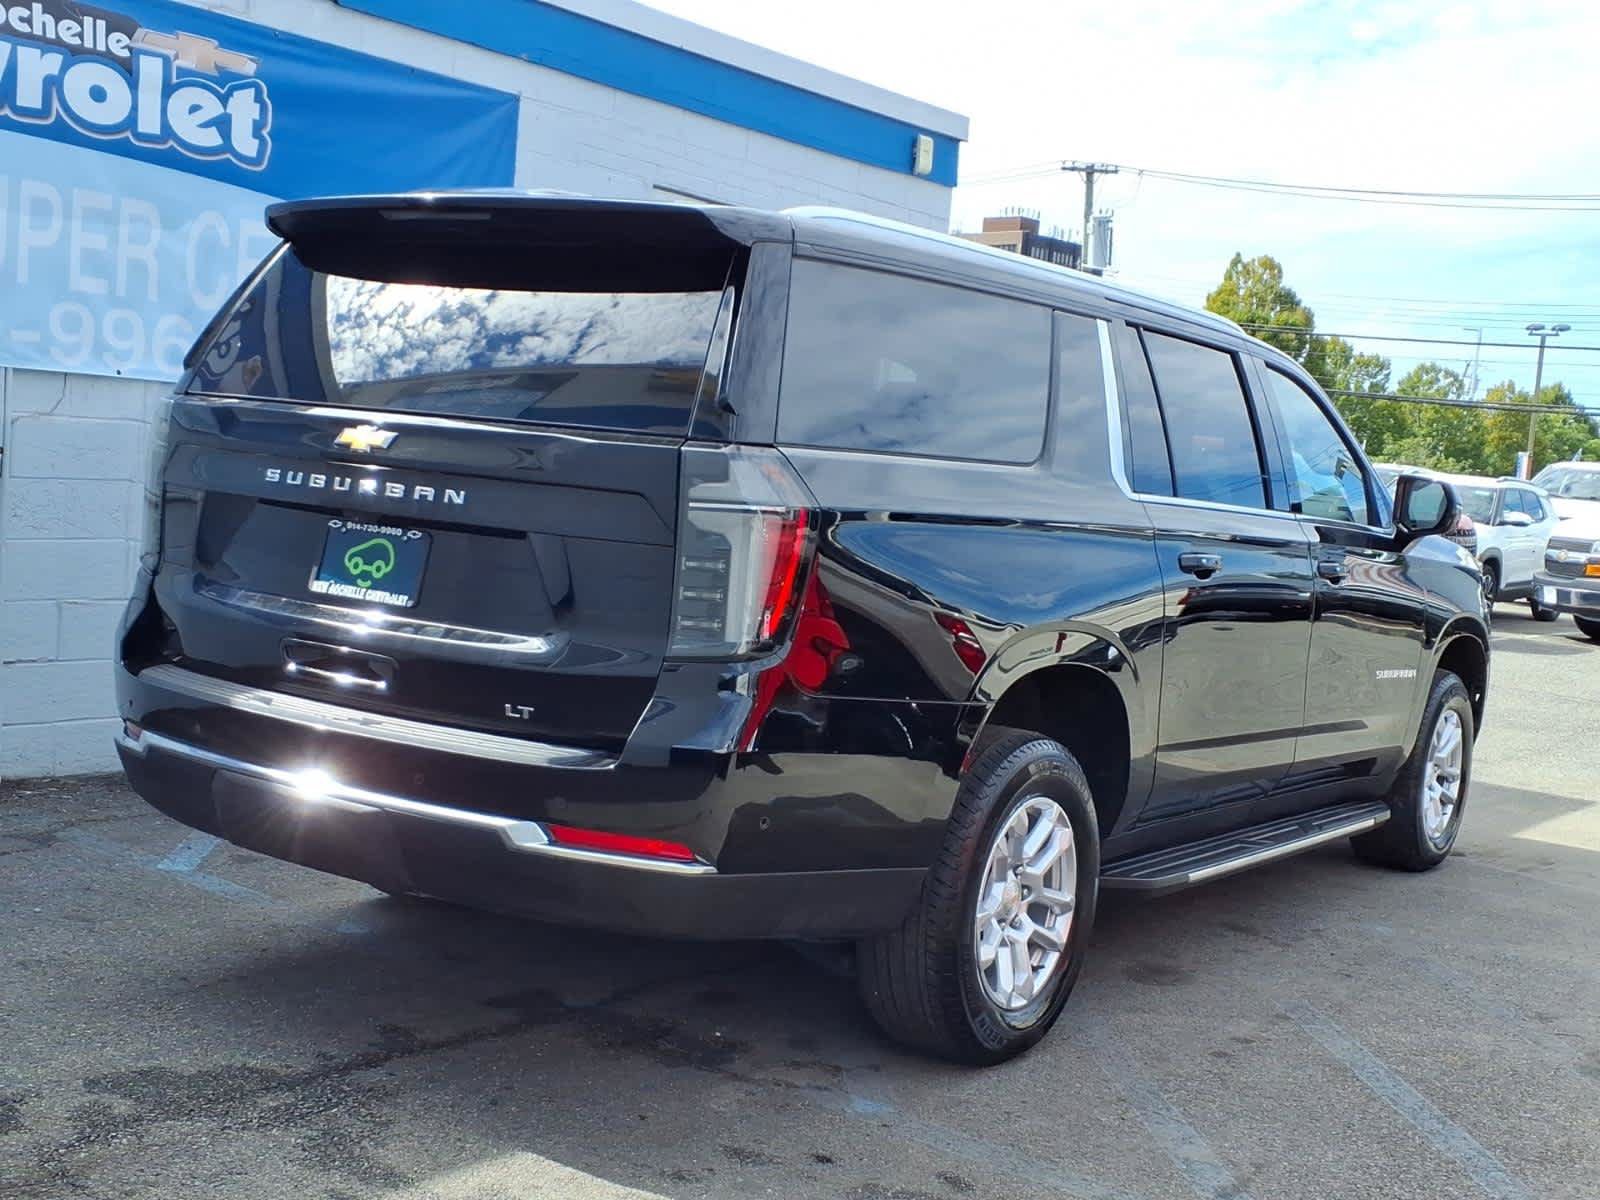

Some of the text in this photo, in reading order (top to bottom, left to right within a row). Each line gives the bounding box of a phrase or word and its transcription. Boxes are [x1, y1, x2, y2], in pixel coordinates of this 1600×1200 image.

[0, 174, 159, 303] PER
[265, 468, 466, 505] SUBURBAN
[504, 703, 535, 719] LT
